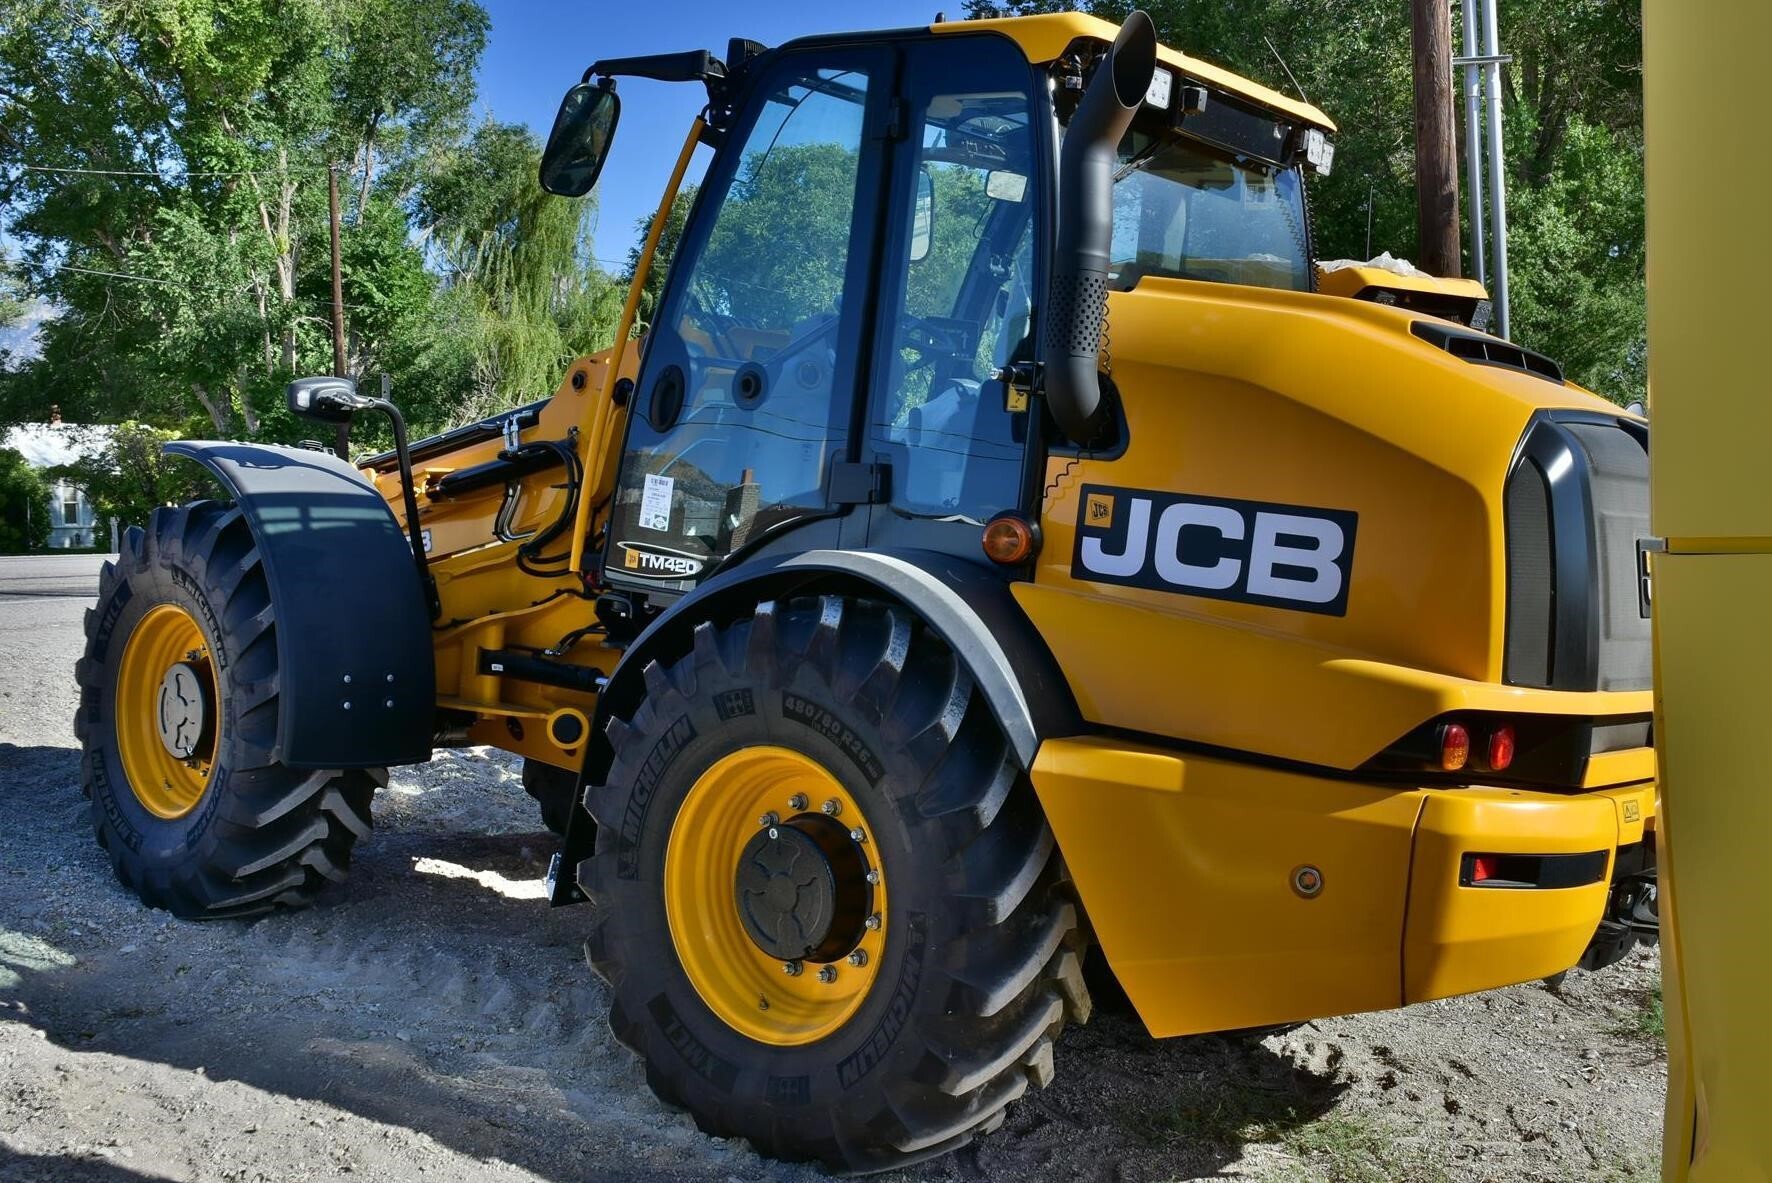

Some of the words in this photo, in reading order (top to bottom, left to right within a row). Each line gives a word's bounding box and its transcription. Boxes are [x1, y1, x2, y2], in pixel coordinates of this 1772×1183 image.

[640, 553, 698, 575] TM420
[1081, 498, 1344, 603] JCB
[183, 580, 227, 666] MICHELIN
[623, 717, 692, 844] MICHELIN
